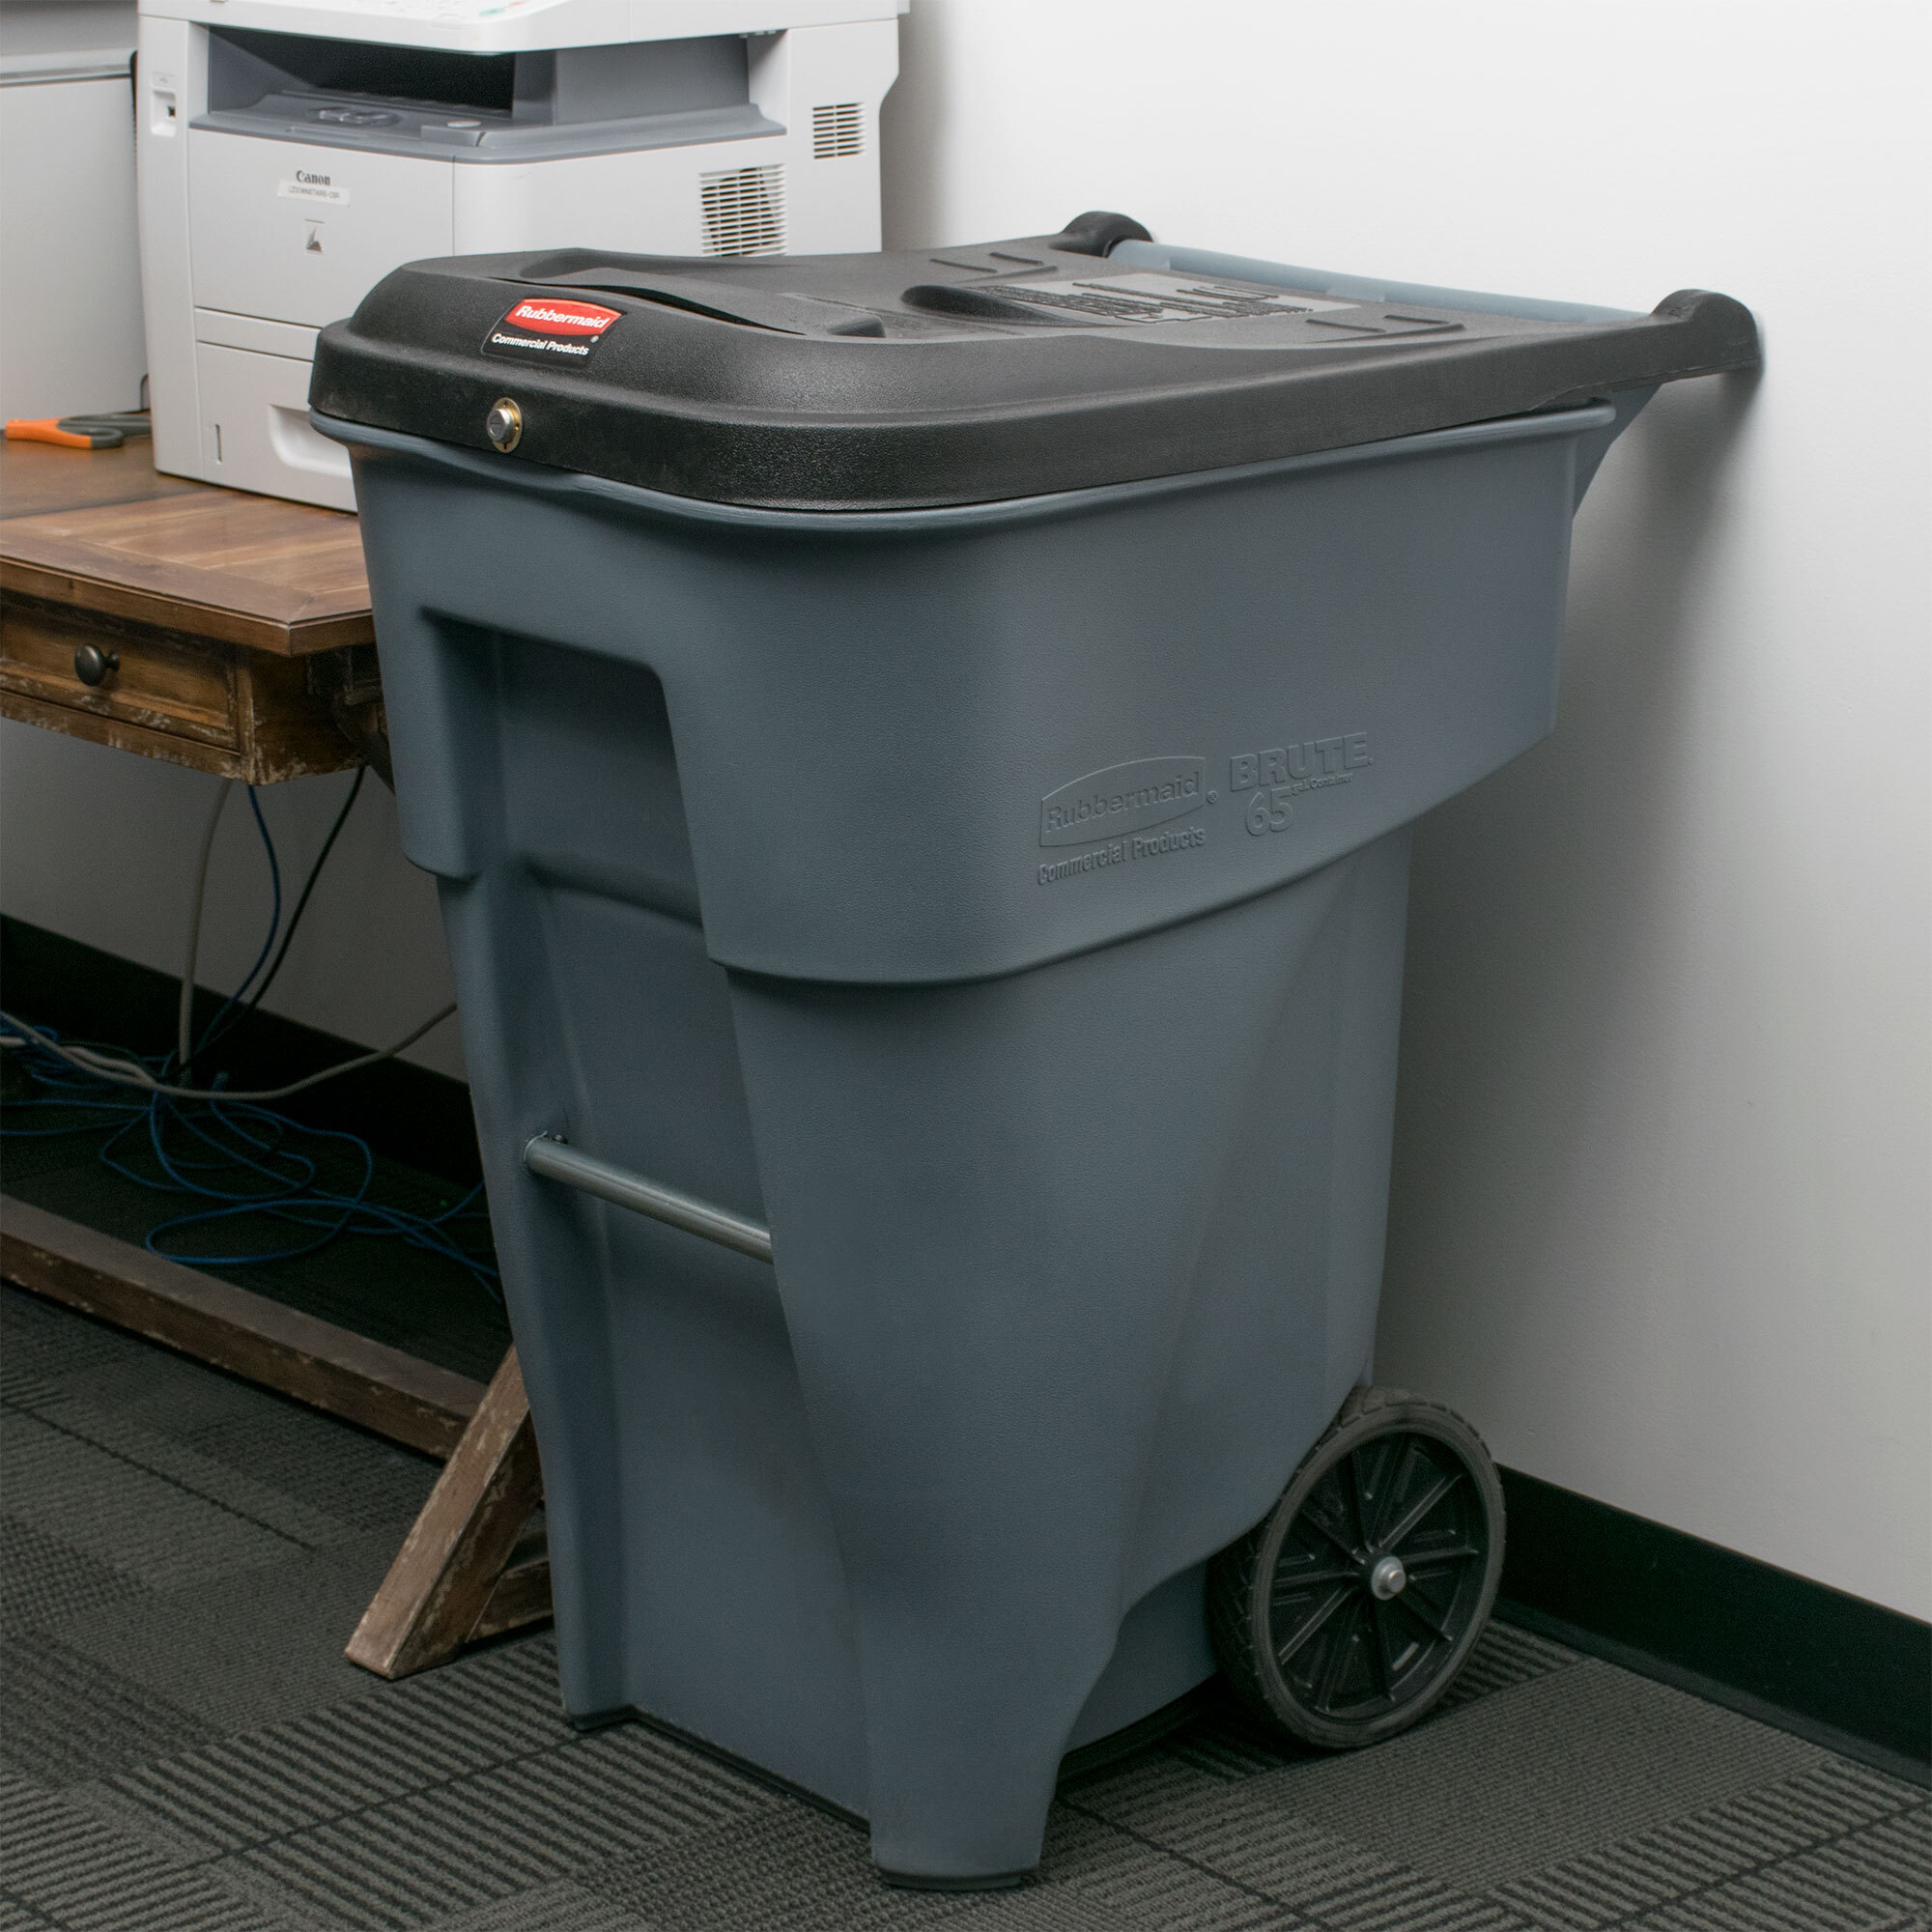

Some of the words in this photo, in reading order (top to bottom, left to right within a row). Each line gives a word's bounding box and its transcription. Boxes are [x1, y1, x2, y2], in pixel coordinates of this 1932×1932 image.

[296, 170, 330, 185] Canon
[515, 305, 610, 328] Rubbermaid
[492, 333, 548, 350] Commercial
[546, 340, 590, 355] Products
[1230, 731, 1368, 792] BRUTE
[1045, 771, 1200, 833] Rubbermaid
[1246, 791, 1294, 838] 65
[1038, 840, 1127, 886] Commercial
[1132, 826, 1207, 862] Products
